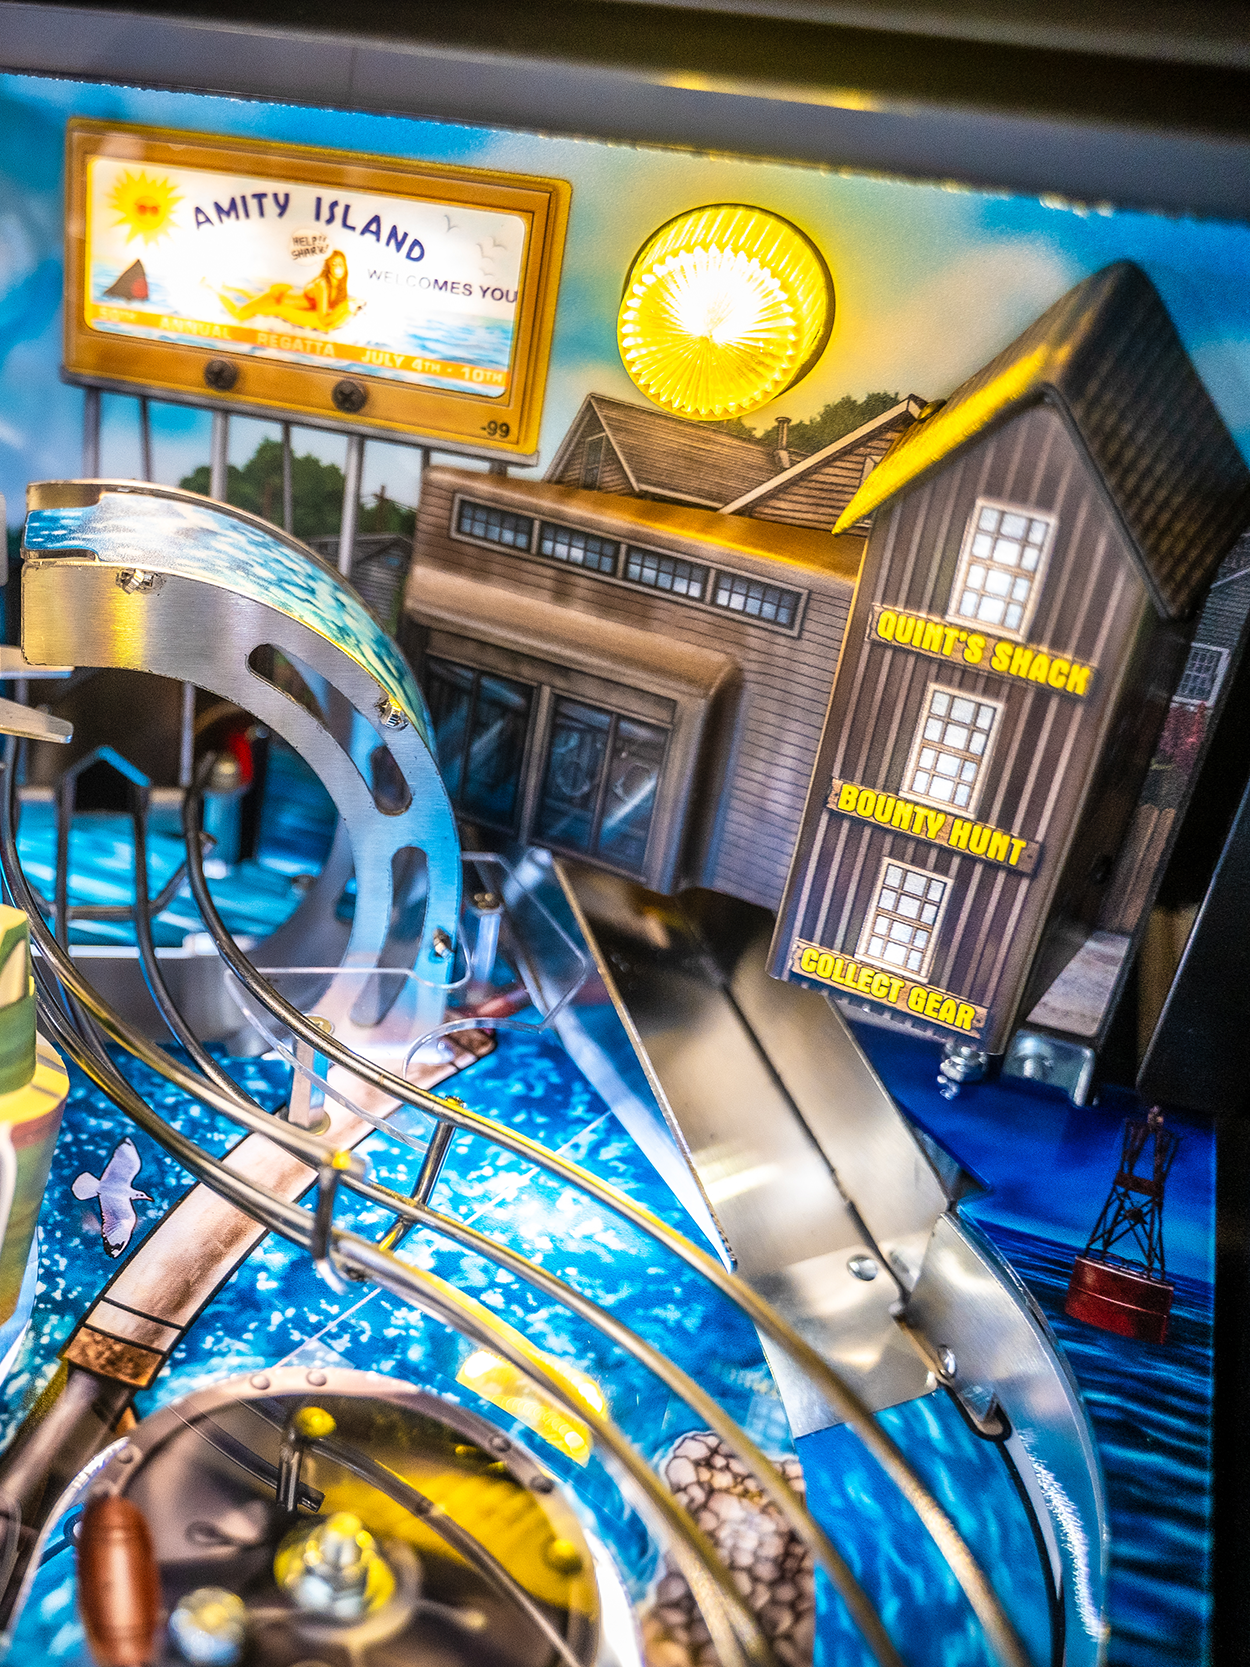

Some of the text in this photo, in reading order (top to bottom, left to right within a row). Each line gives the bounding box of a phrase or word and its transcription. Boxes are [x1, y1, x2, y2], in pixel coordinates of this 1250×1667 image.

[194, 192, 425, 262] AMITY ISLAND
[367, 268, 518, 303] WELCOMES YOU
[159, 317, 232, 340] ANNUAL
[256, 333, 336, 357] REGATTA
[361, 351, 405, 369] JULY
[411, 358, 441, 373] 4TH
[460, 367, 503, 383] 10TH
[480, 420, 510, 438] -99
[877, 611, 1093, 697] QUINT'S SHACK
[837, 784, 1027, 867] BOUNTY HUNT
[800, 947, 977, 1030] COLLECT GEAR
